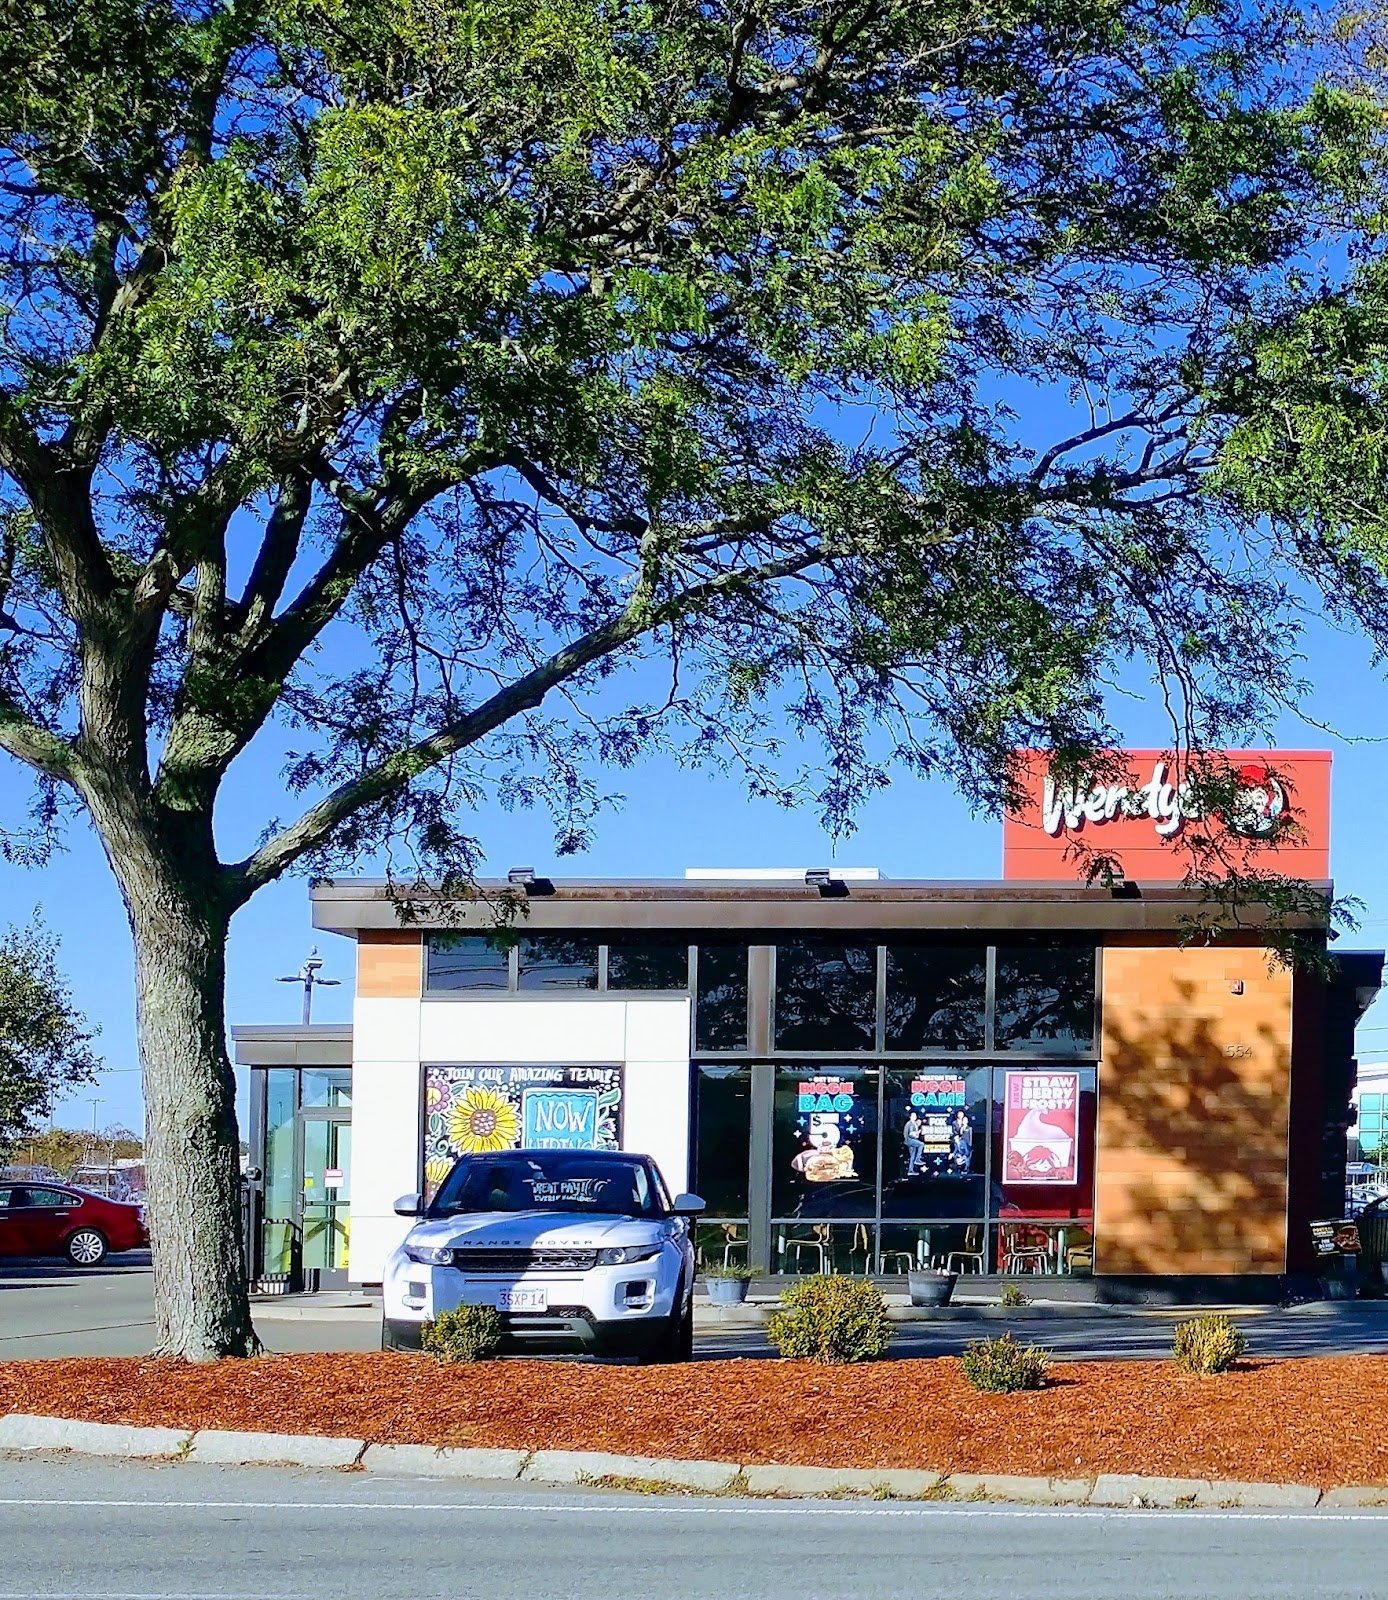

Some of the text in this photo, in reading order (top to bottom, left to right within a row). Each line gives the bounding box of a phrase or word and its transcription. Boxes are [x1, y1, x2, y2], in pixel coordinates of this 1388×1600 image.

[1225, 1044, 1253, 1058] 554
[445, 1067, 475, 1081] JOIN
[477, 1067, 504, 1084] OUR
[510, 1067, 566, 1082] AMAZING
[1022, 1076, 1075, 1088] STRAW
[799, 1082, 854, 1095] BIGGIE
[911, 1080, 966, 1093] BIGGIE
[910, 1092, 966, 1106] GAME
[1022, 1087, 1074, 1100] BERRY
[798, 1094, 854, 1112] BAG
[1022, 1099, 1075, 1110] FROSTY
[534, 1100, 593, 1133] NOW
[531, 1293, 544, 1306] 14
